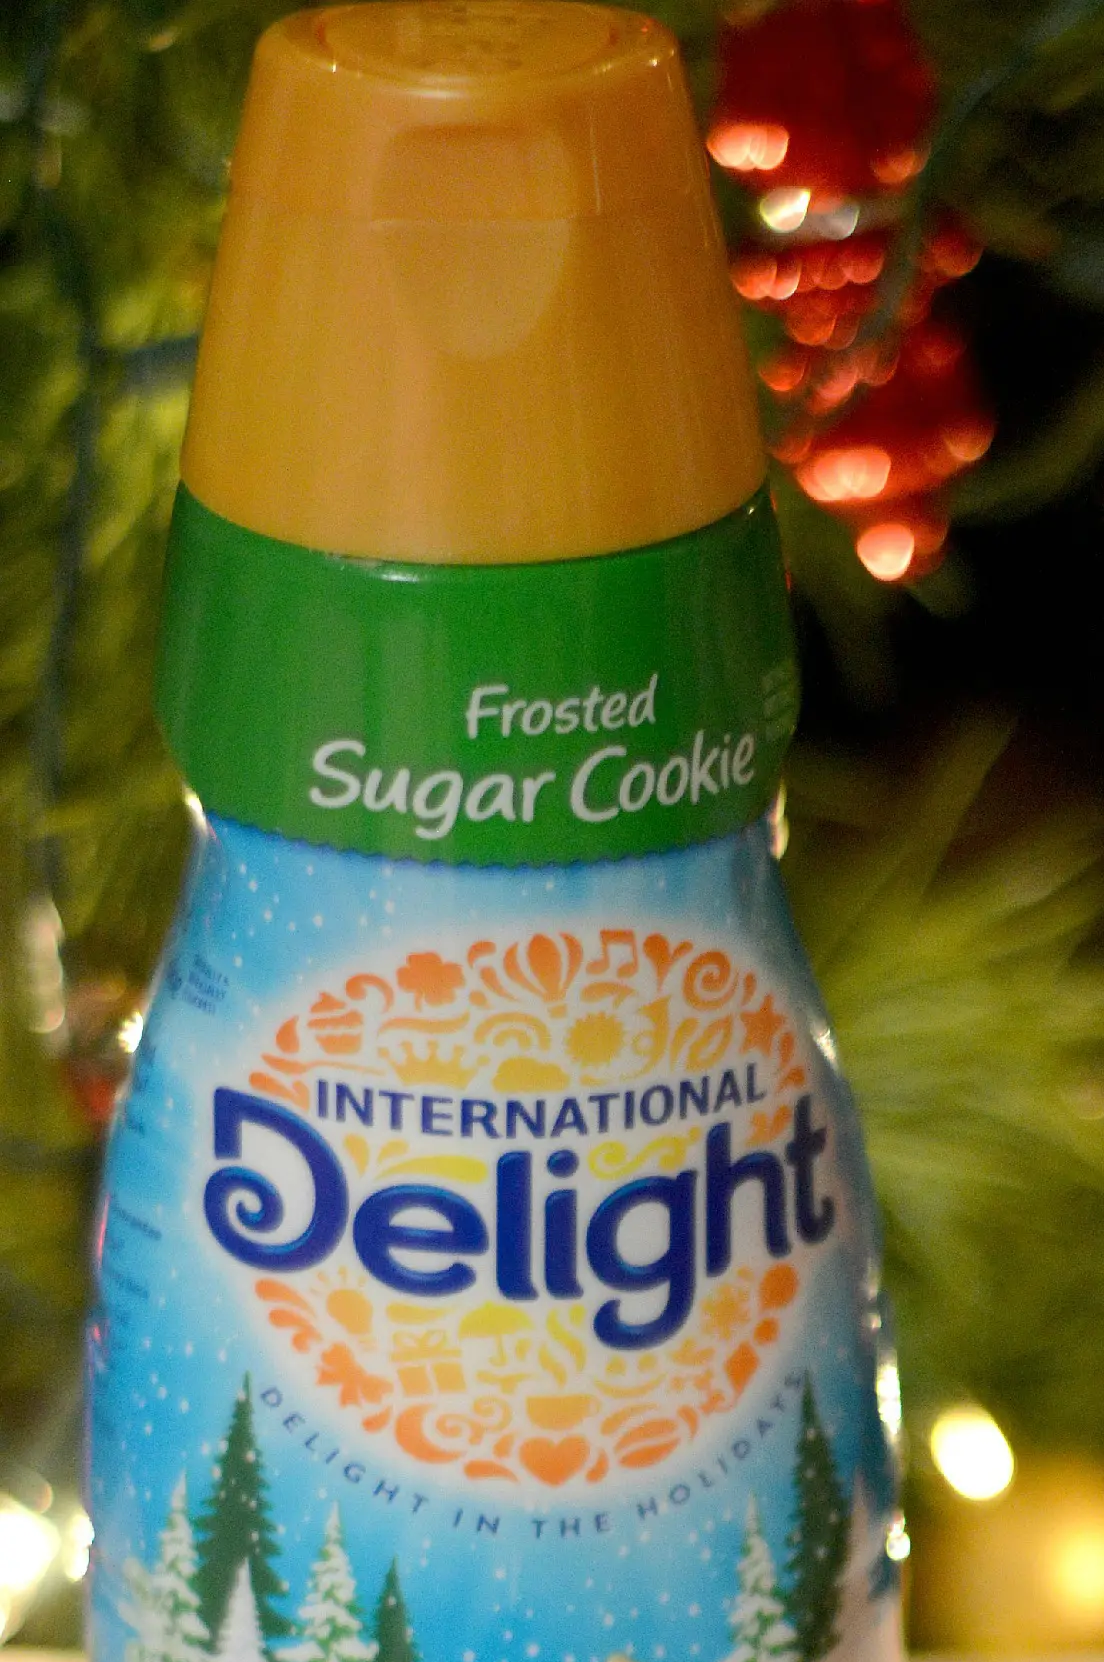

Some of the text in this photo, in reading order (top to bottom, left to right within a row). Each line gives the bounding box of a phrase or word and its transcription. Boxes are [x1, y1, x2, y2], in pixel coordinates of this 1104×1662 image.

[465, 673, 659, 740] Frosted
[309, 731, 756, 841] Sugar Cookie
[315, 1063, 767, 1139] INTERNATIONAL
[203, 1084, 837, 1352] Delight
[259, 1371, 804, 1540] DELIGHT IN THE HOLIDAYS
